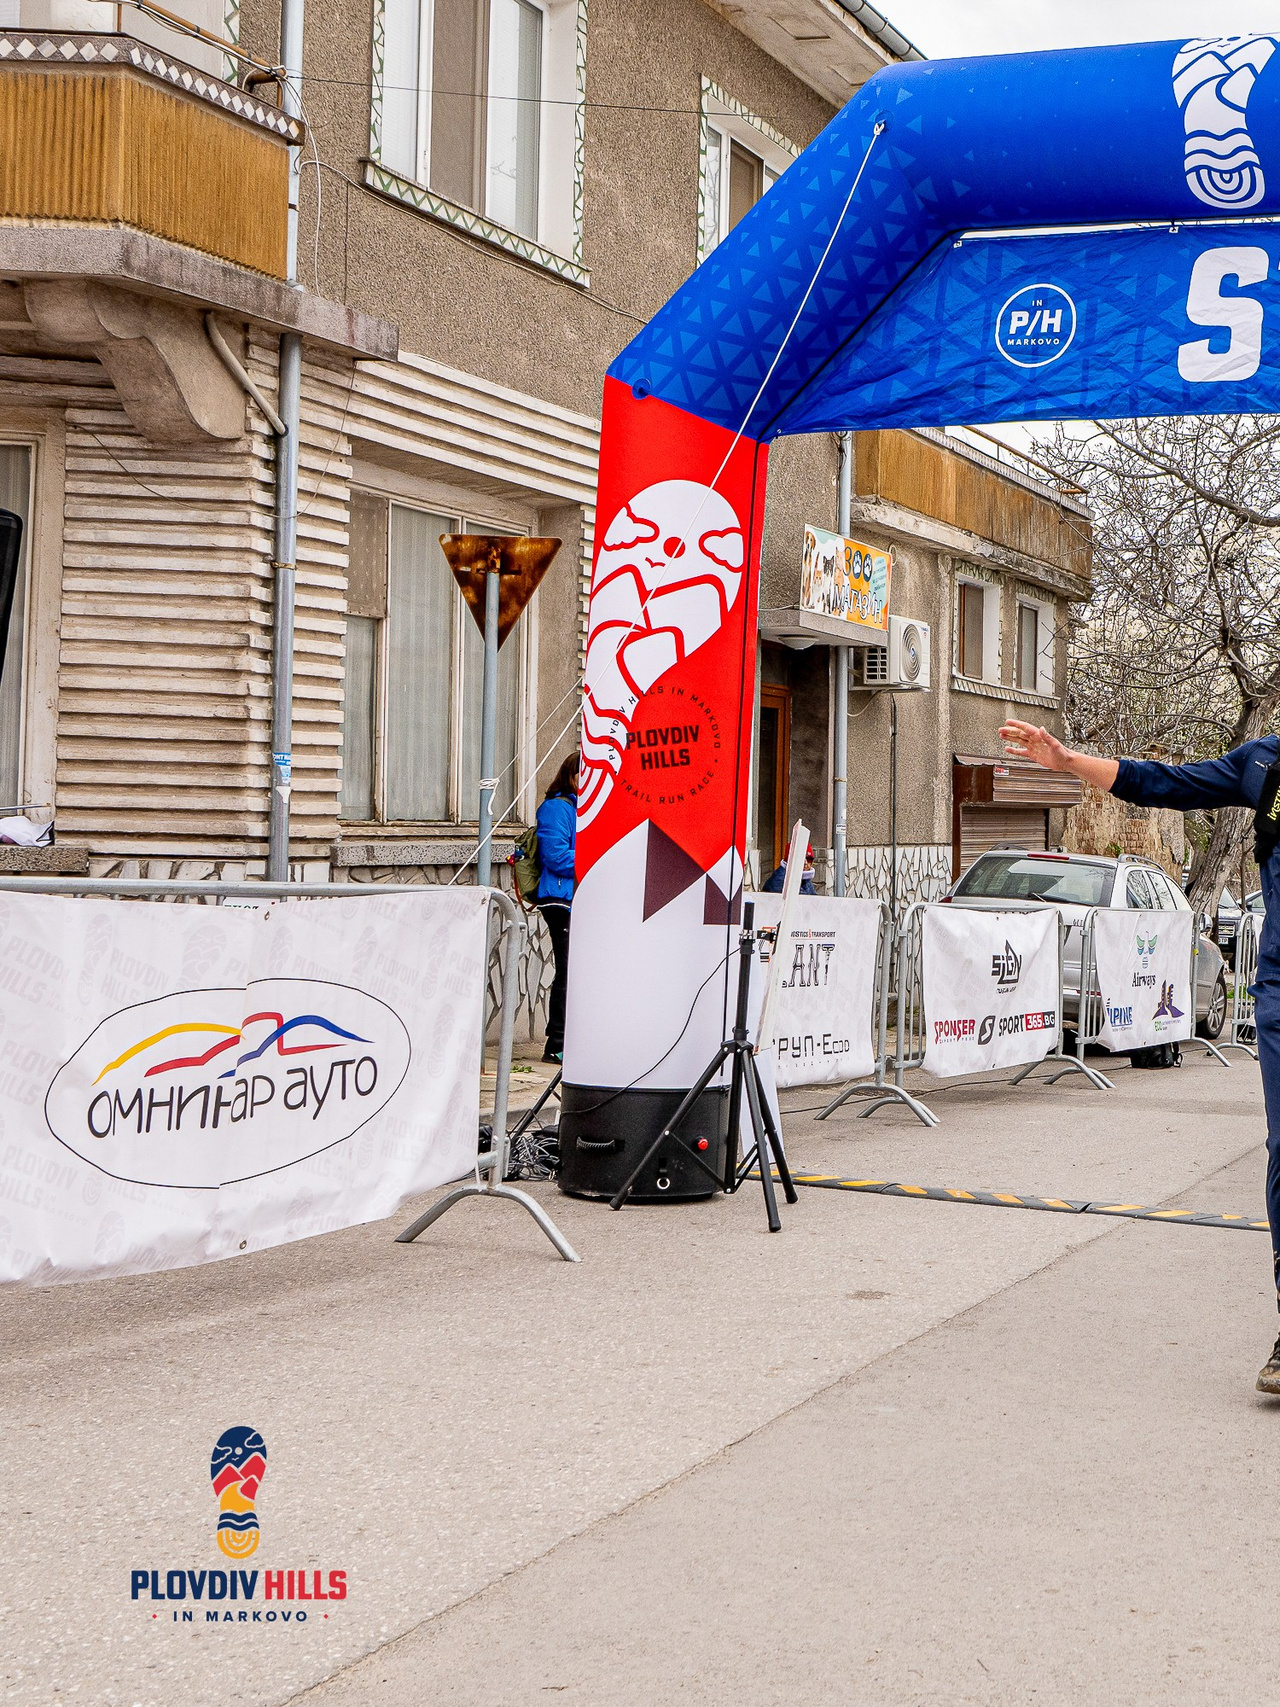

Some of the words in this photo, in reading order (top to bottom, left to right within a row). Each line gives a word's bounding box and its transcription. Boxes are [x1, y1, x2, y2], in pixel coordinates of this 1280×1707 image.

[1032, 299, 1043, 307] IN
[1009, 309, 1062, 336] P/H
[1007, 338, 1060, 346] MARKOVO
[834, 583, 883, 624] МАГАЗИН
[671, 686, 685, 696] IN
[690, 694, 721, 749] MARKOVO
[626, 724, 700, 750] PLOVDIV
[641, 748, 691, 770] HILLS
[620, 779, 651, 803] TRAIL
[659, 794, 685, 804] RUN
[689, 770, 715, 796] RACE
[1132, 972, 1156, 989] Airways
[934, 1019, 976, 1045] SPONSER
